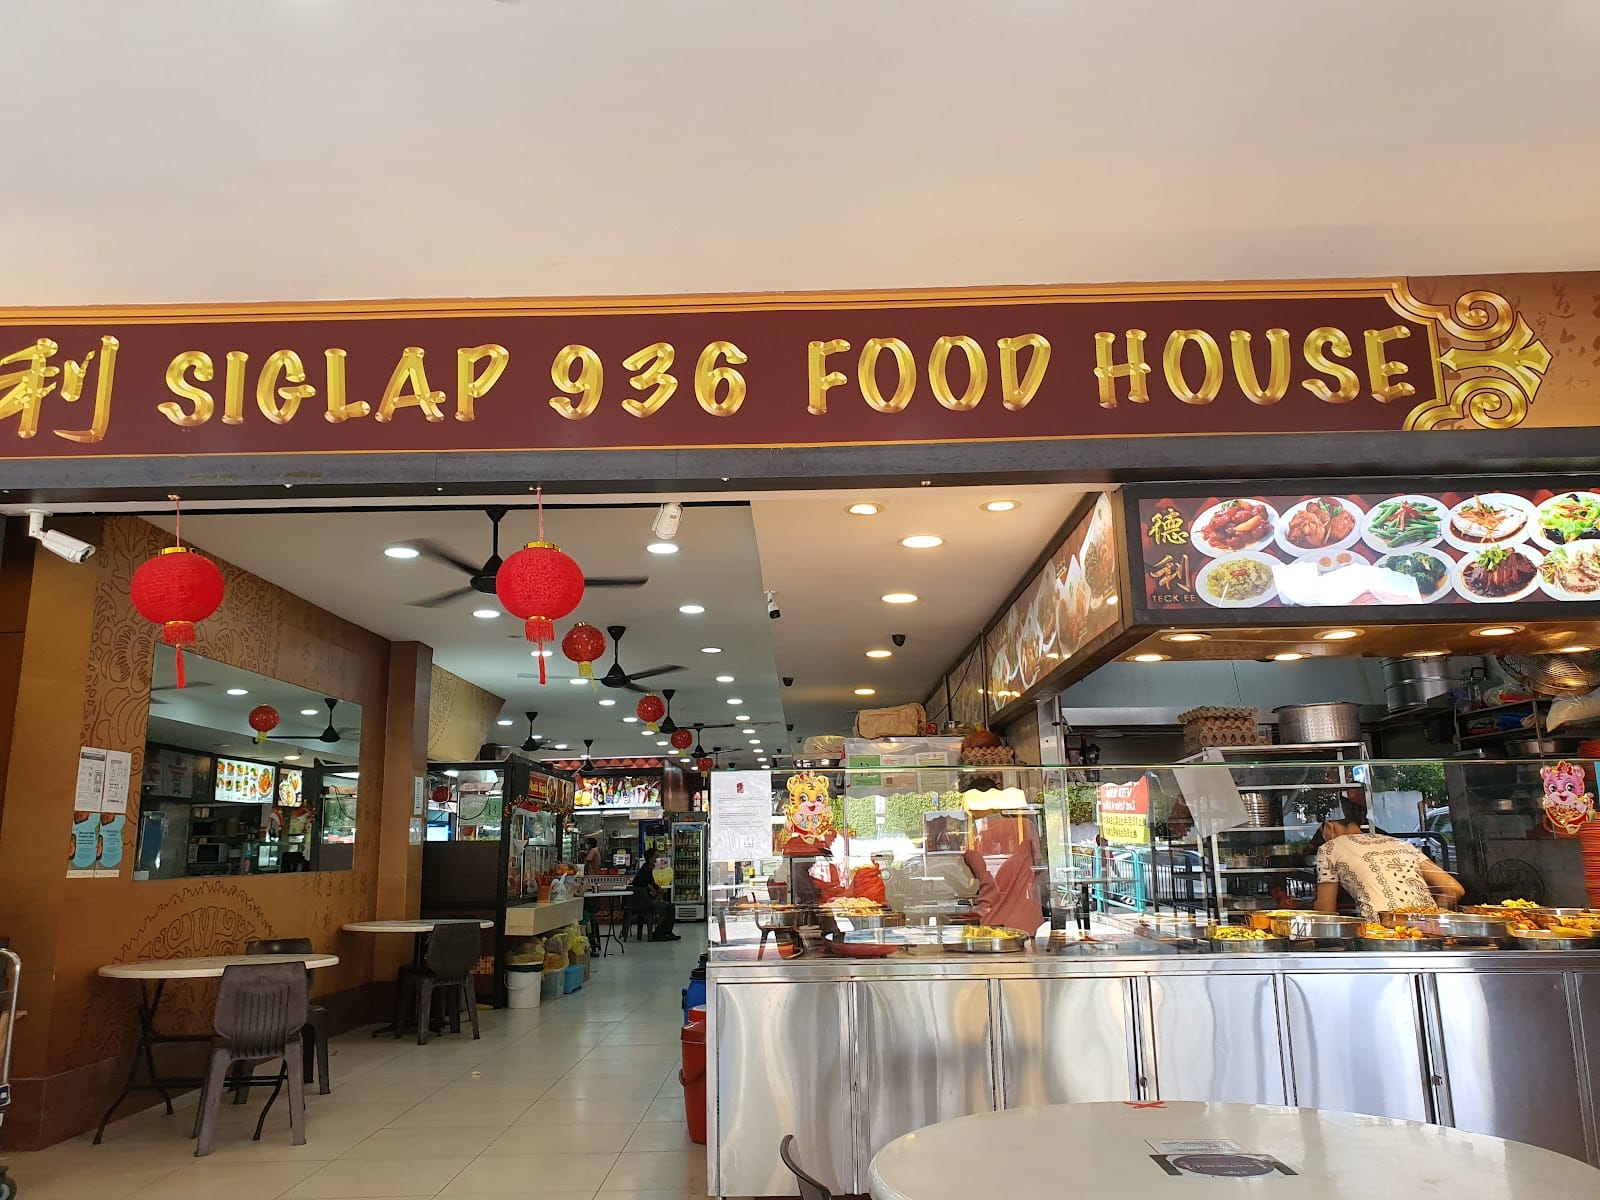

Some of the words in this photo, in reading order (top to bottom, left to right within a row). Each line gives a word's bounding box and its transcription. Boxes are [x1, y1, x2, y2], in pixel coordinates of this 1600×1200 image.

[156, 342, 510, 427] SIGLAP
[548, 340, 748, 421] 936
[806, 332, 1051, 416] FOOD
[1093, 324, 1416, 409] HOUSE
[1148, 508, 1191, 593] 德利
[1152, 595, 1180, 604] TECK
[1184, 594, 1198, 603] EE
